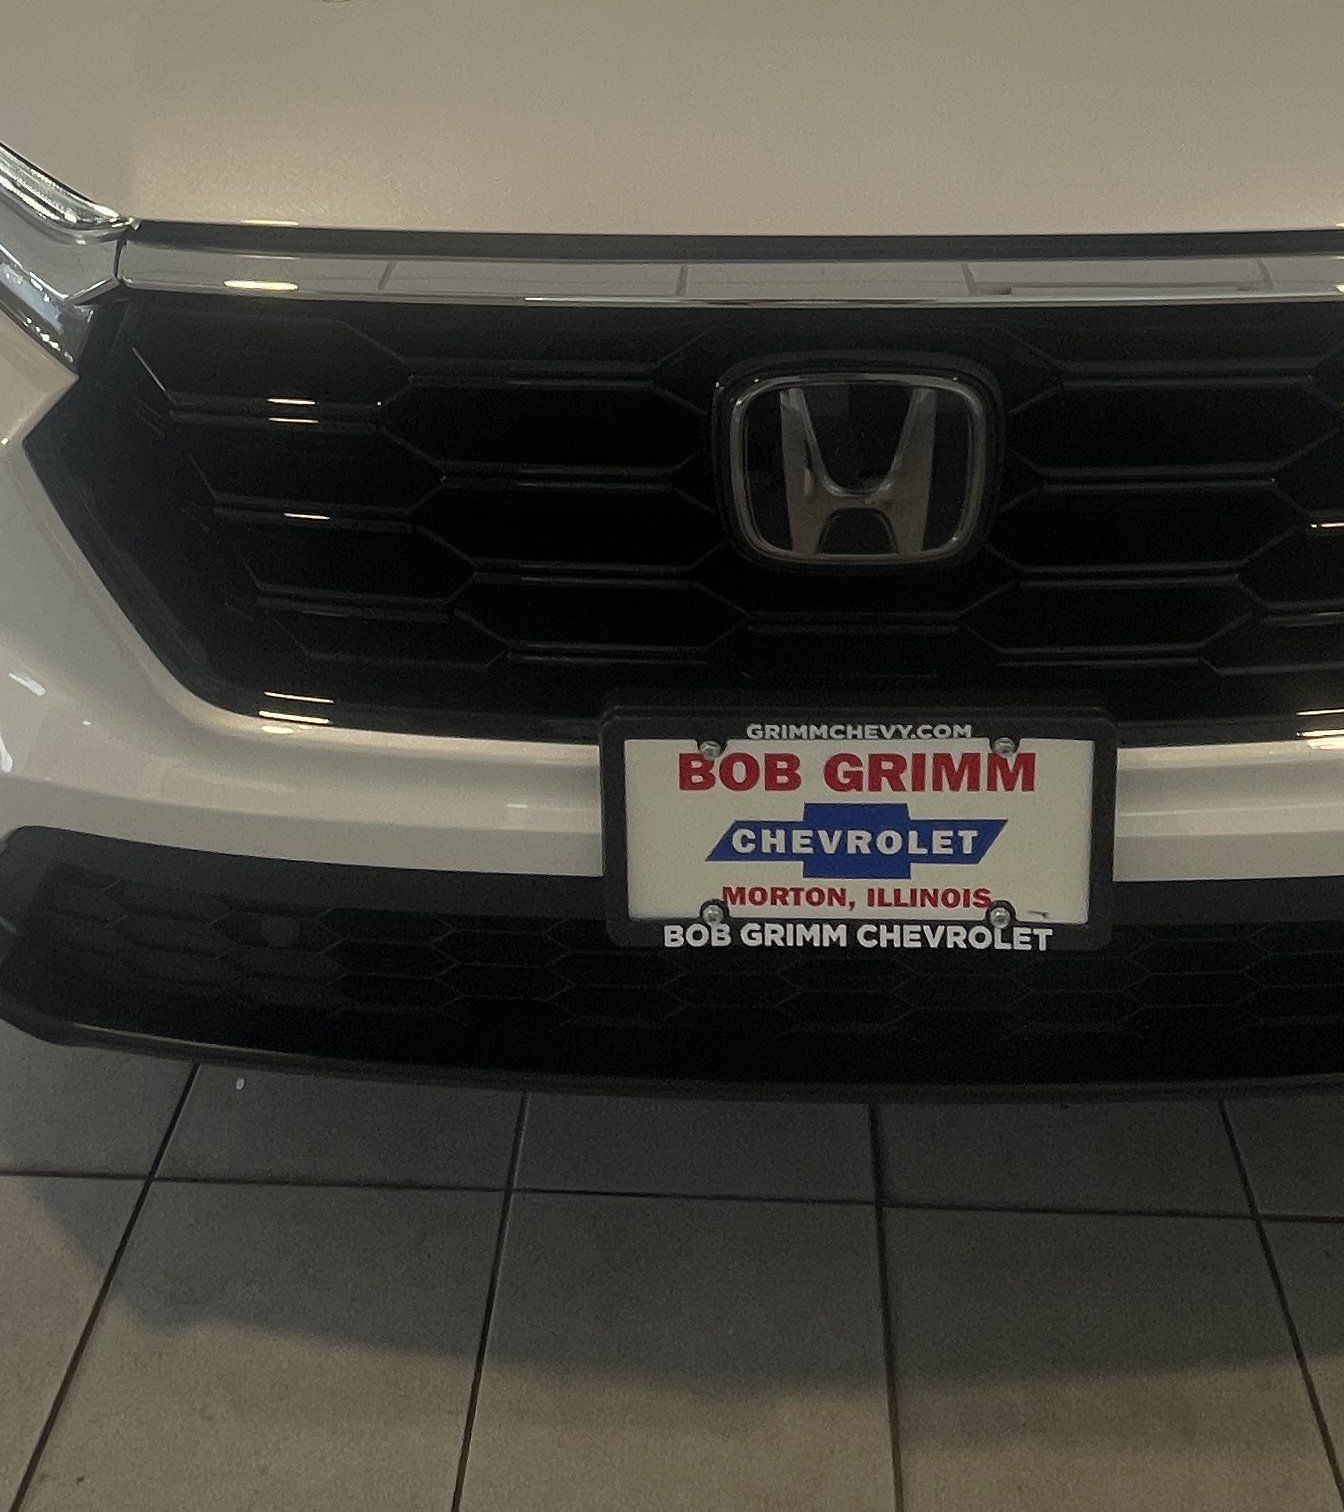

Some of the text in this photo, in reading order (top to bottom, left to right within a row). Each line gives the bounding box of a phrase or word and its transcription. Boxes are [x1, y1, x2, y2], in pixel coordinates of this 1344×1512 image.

[746, 723, 973, 741] GRIMMCHEVY.COM
[678, 752, 1037, 793] BOB GRIMM
[731, 829, 980, 856] CHEVROLET
[721, 886, 993, 911] MORTON, ILLINOIS
[663, 922, 1053, 952] BOB GRIMM CHEVROLET
